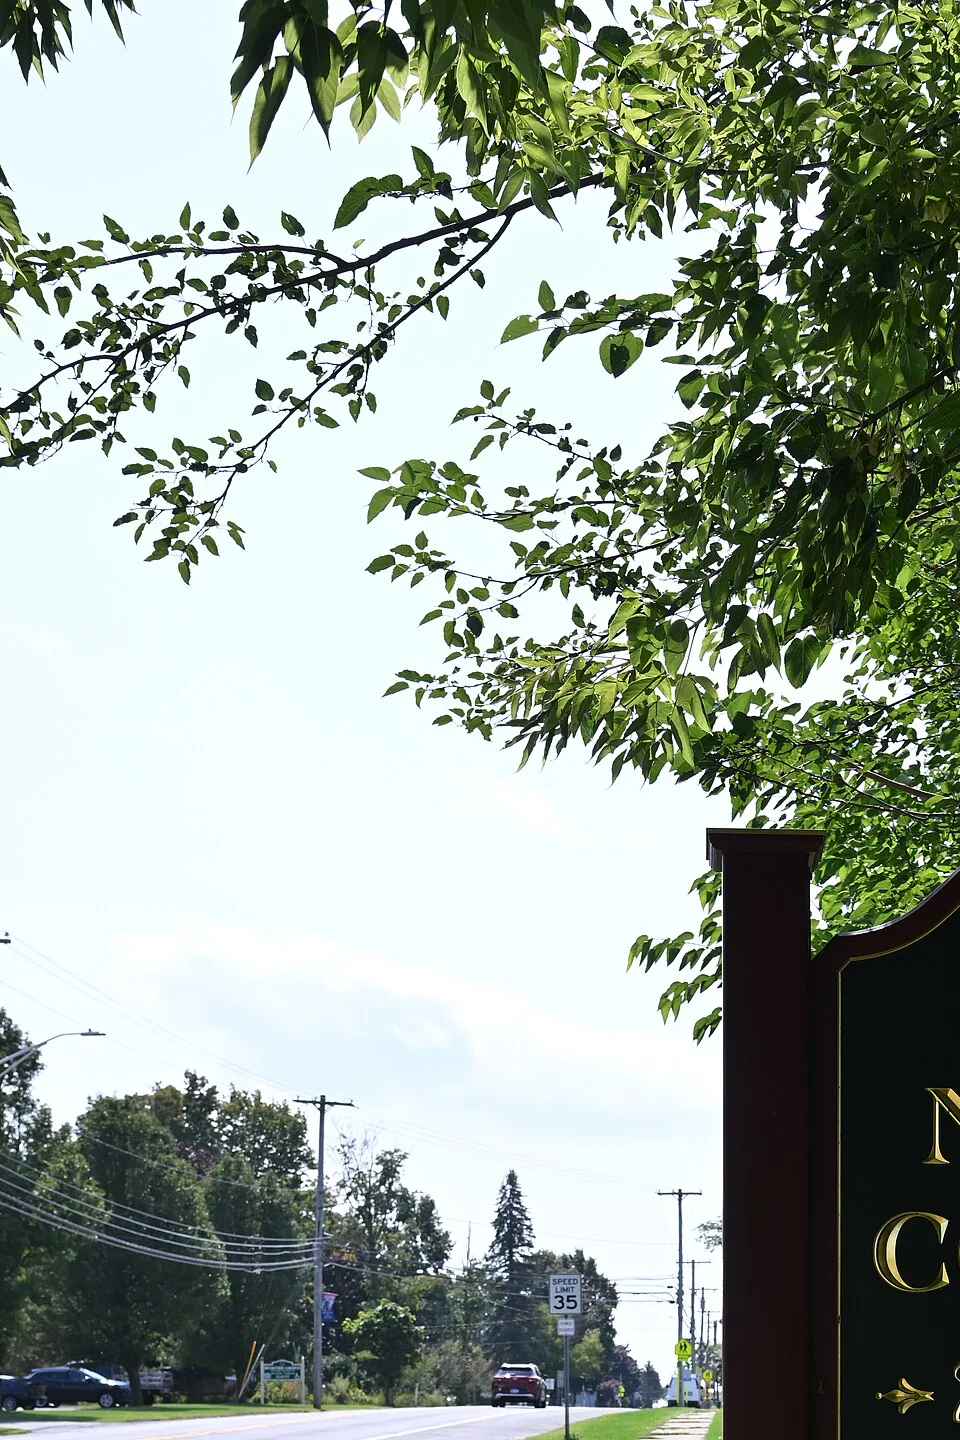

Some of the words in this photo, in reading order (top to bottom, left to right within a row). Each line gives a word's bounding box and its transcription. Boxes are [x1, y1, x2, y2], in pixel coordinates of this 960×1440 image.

[552, 1278, 579, 1286] SPEED
[555, 1286, 575, 1294] LIMIT
[553, 1294, 578, 1310] 35
